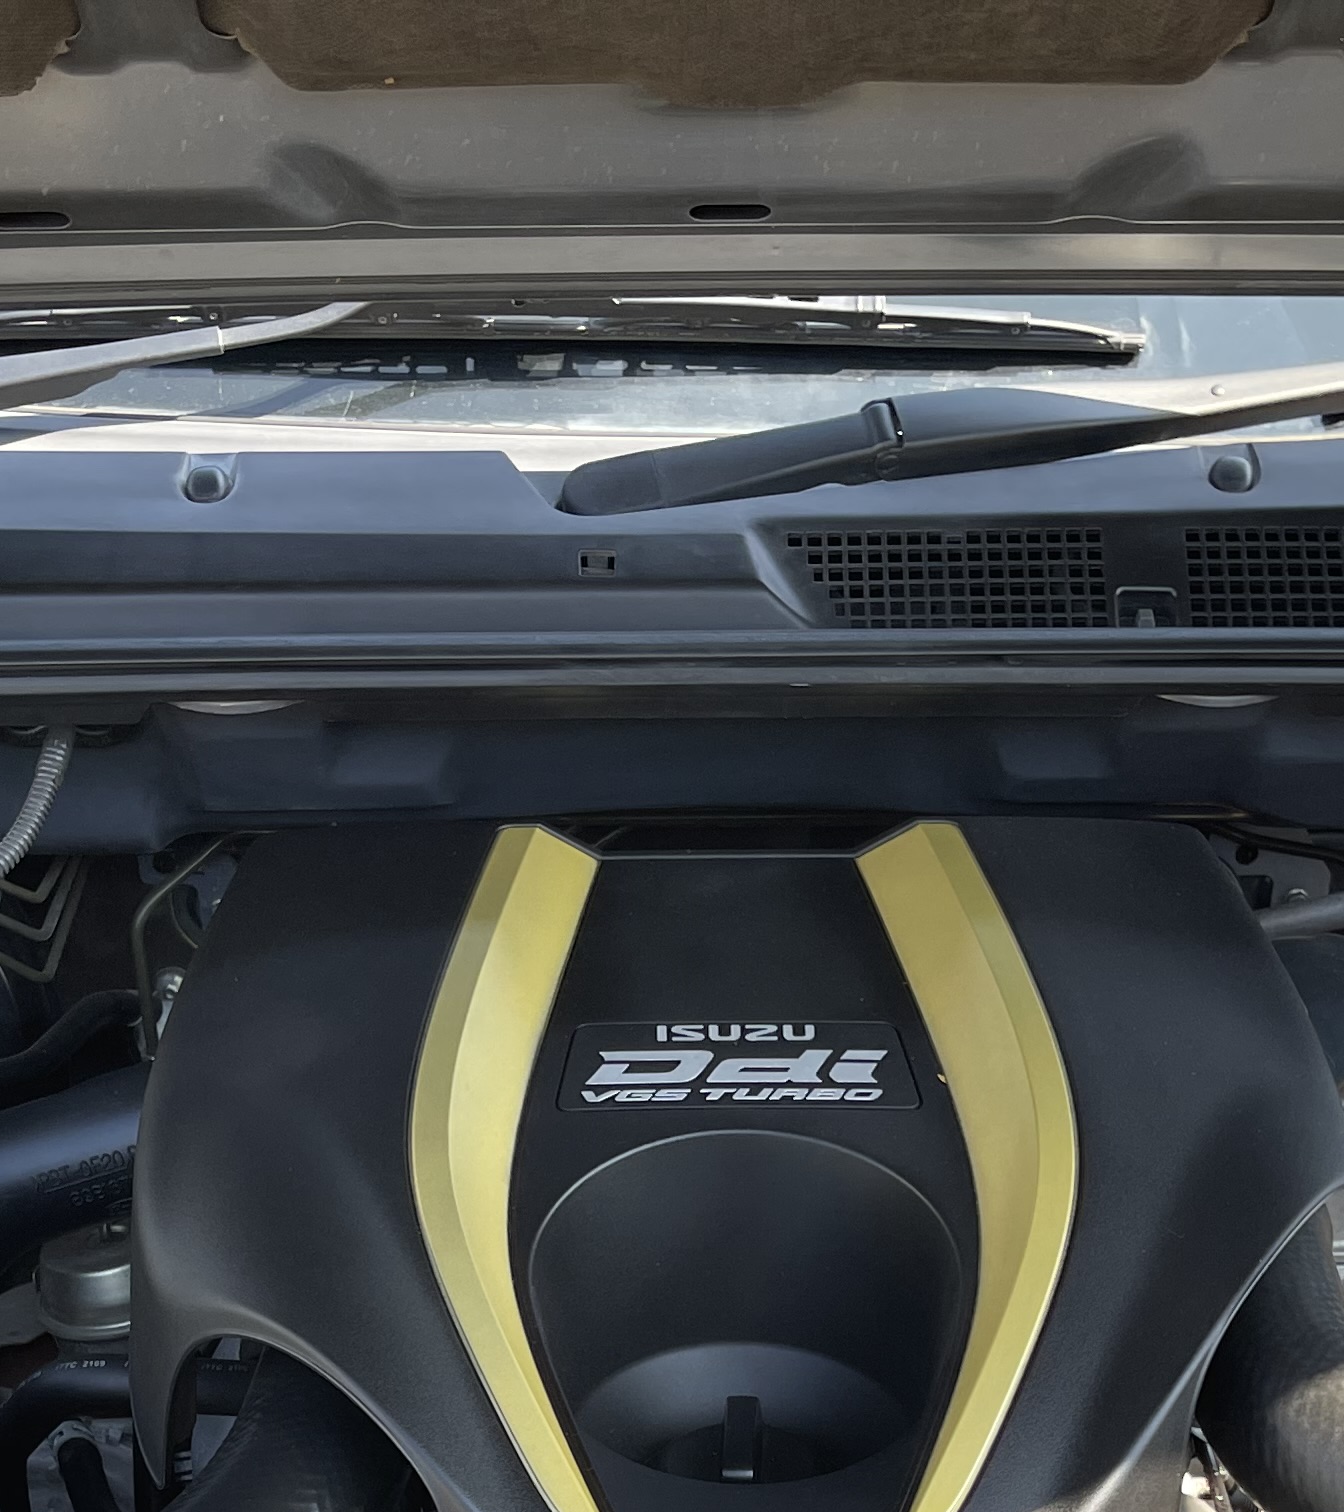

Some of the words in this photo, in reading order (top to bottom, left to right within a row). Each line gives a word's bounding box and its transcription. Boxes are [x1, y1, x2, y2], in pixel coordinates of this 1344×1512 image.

[656, 1024, 815, 1042] ISUZU
[585, 1049, 888, 1085] Ddi
[580, 1089, 691, 1103] VGS
[699, 1088, 883, 1102] TURBO
